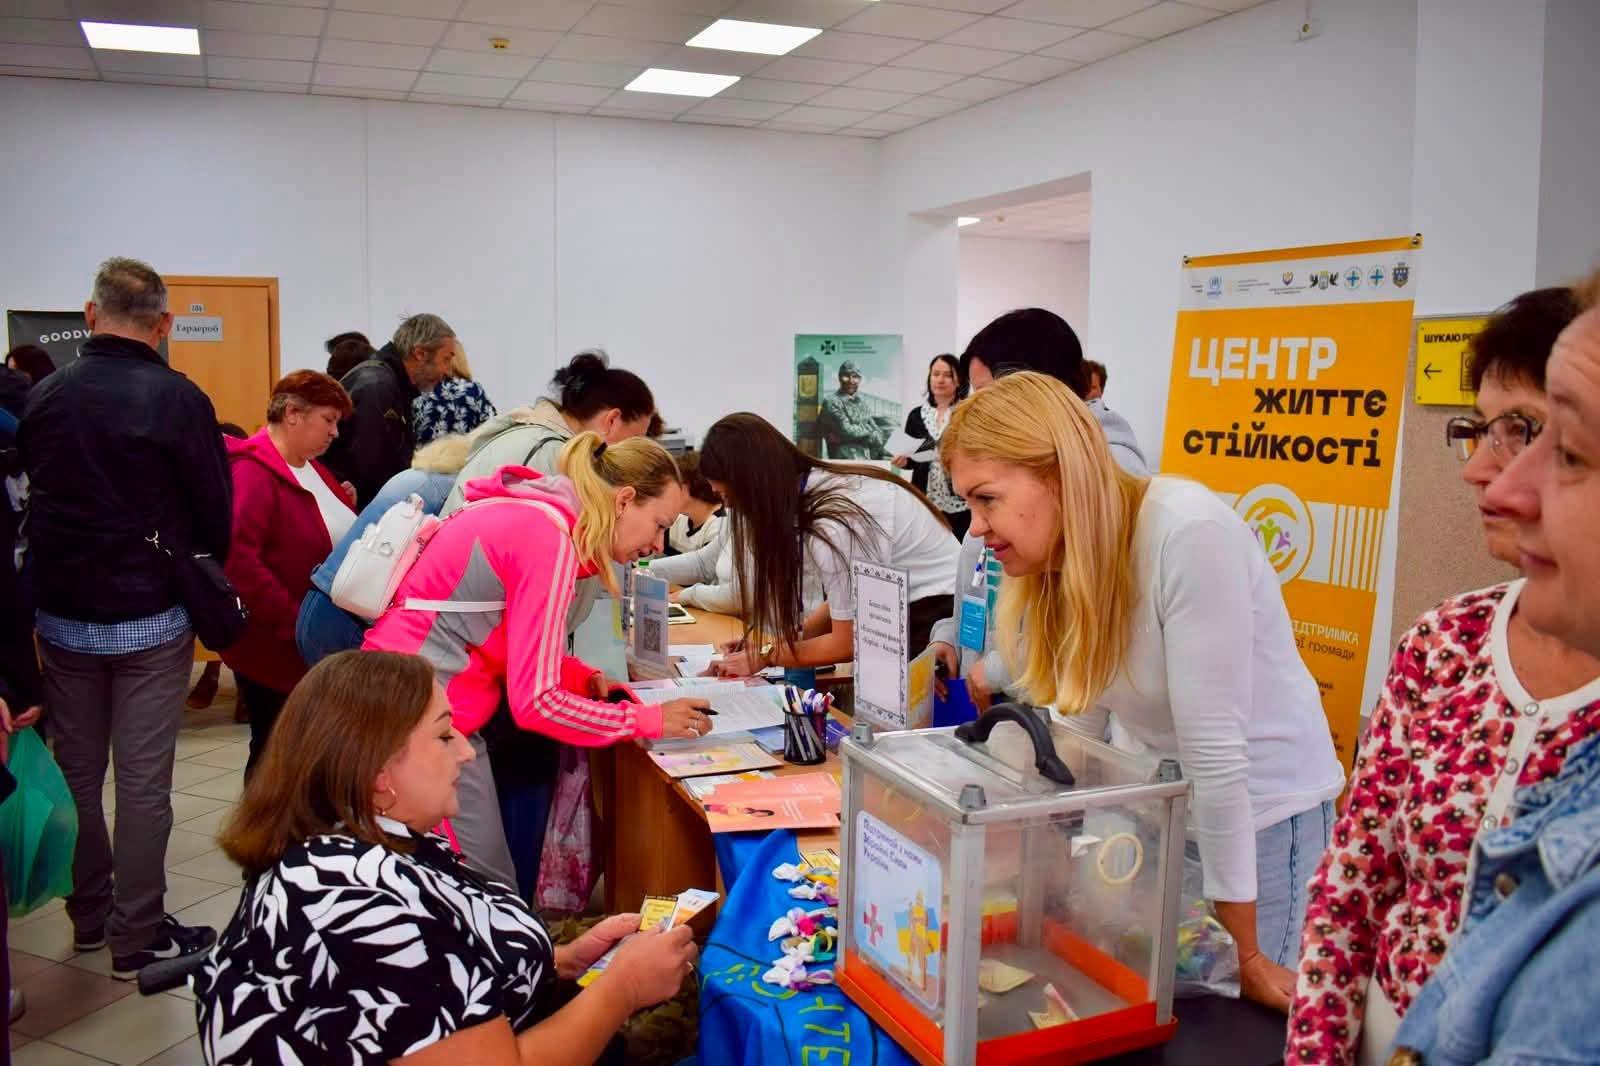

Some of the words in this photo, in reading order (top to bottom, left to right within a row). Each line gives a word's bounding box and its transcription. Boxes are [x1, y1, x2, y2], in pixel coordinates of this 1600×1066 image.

[1424, 333, 1461, 344] ШУКАЮ
[1188, 336, 1338, 387] ЦЕНТР
[1293, 620, 1360, 646] ІДТРИМКА
[1308, 640, 1355, 661] громади
